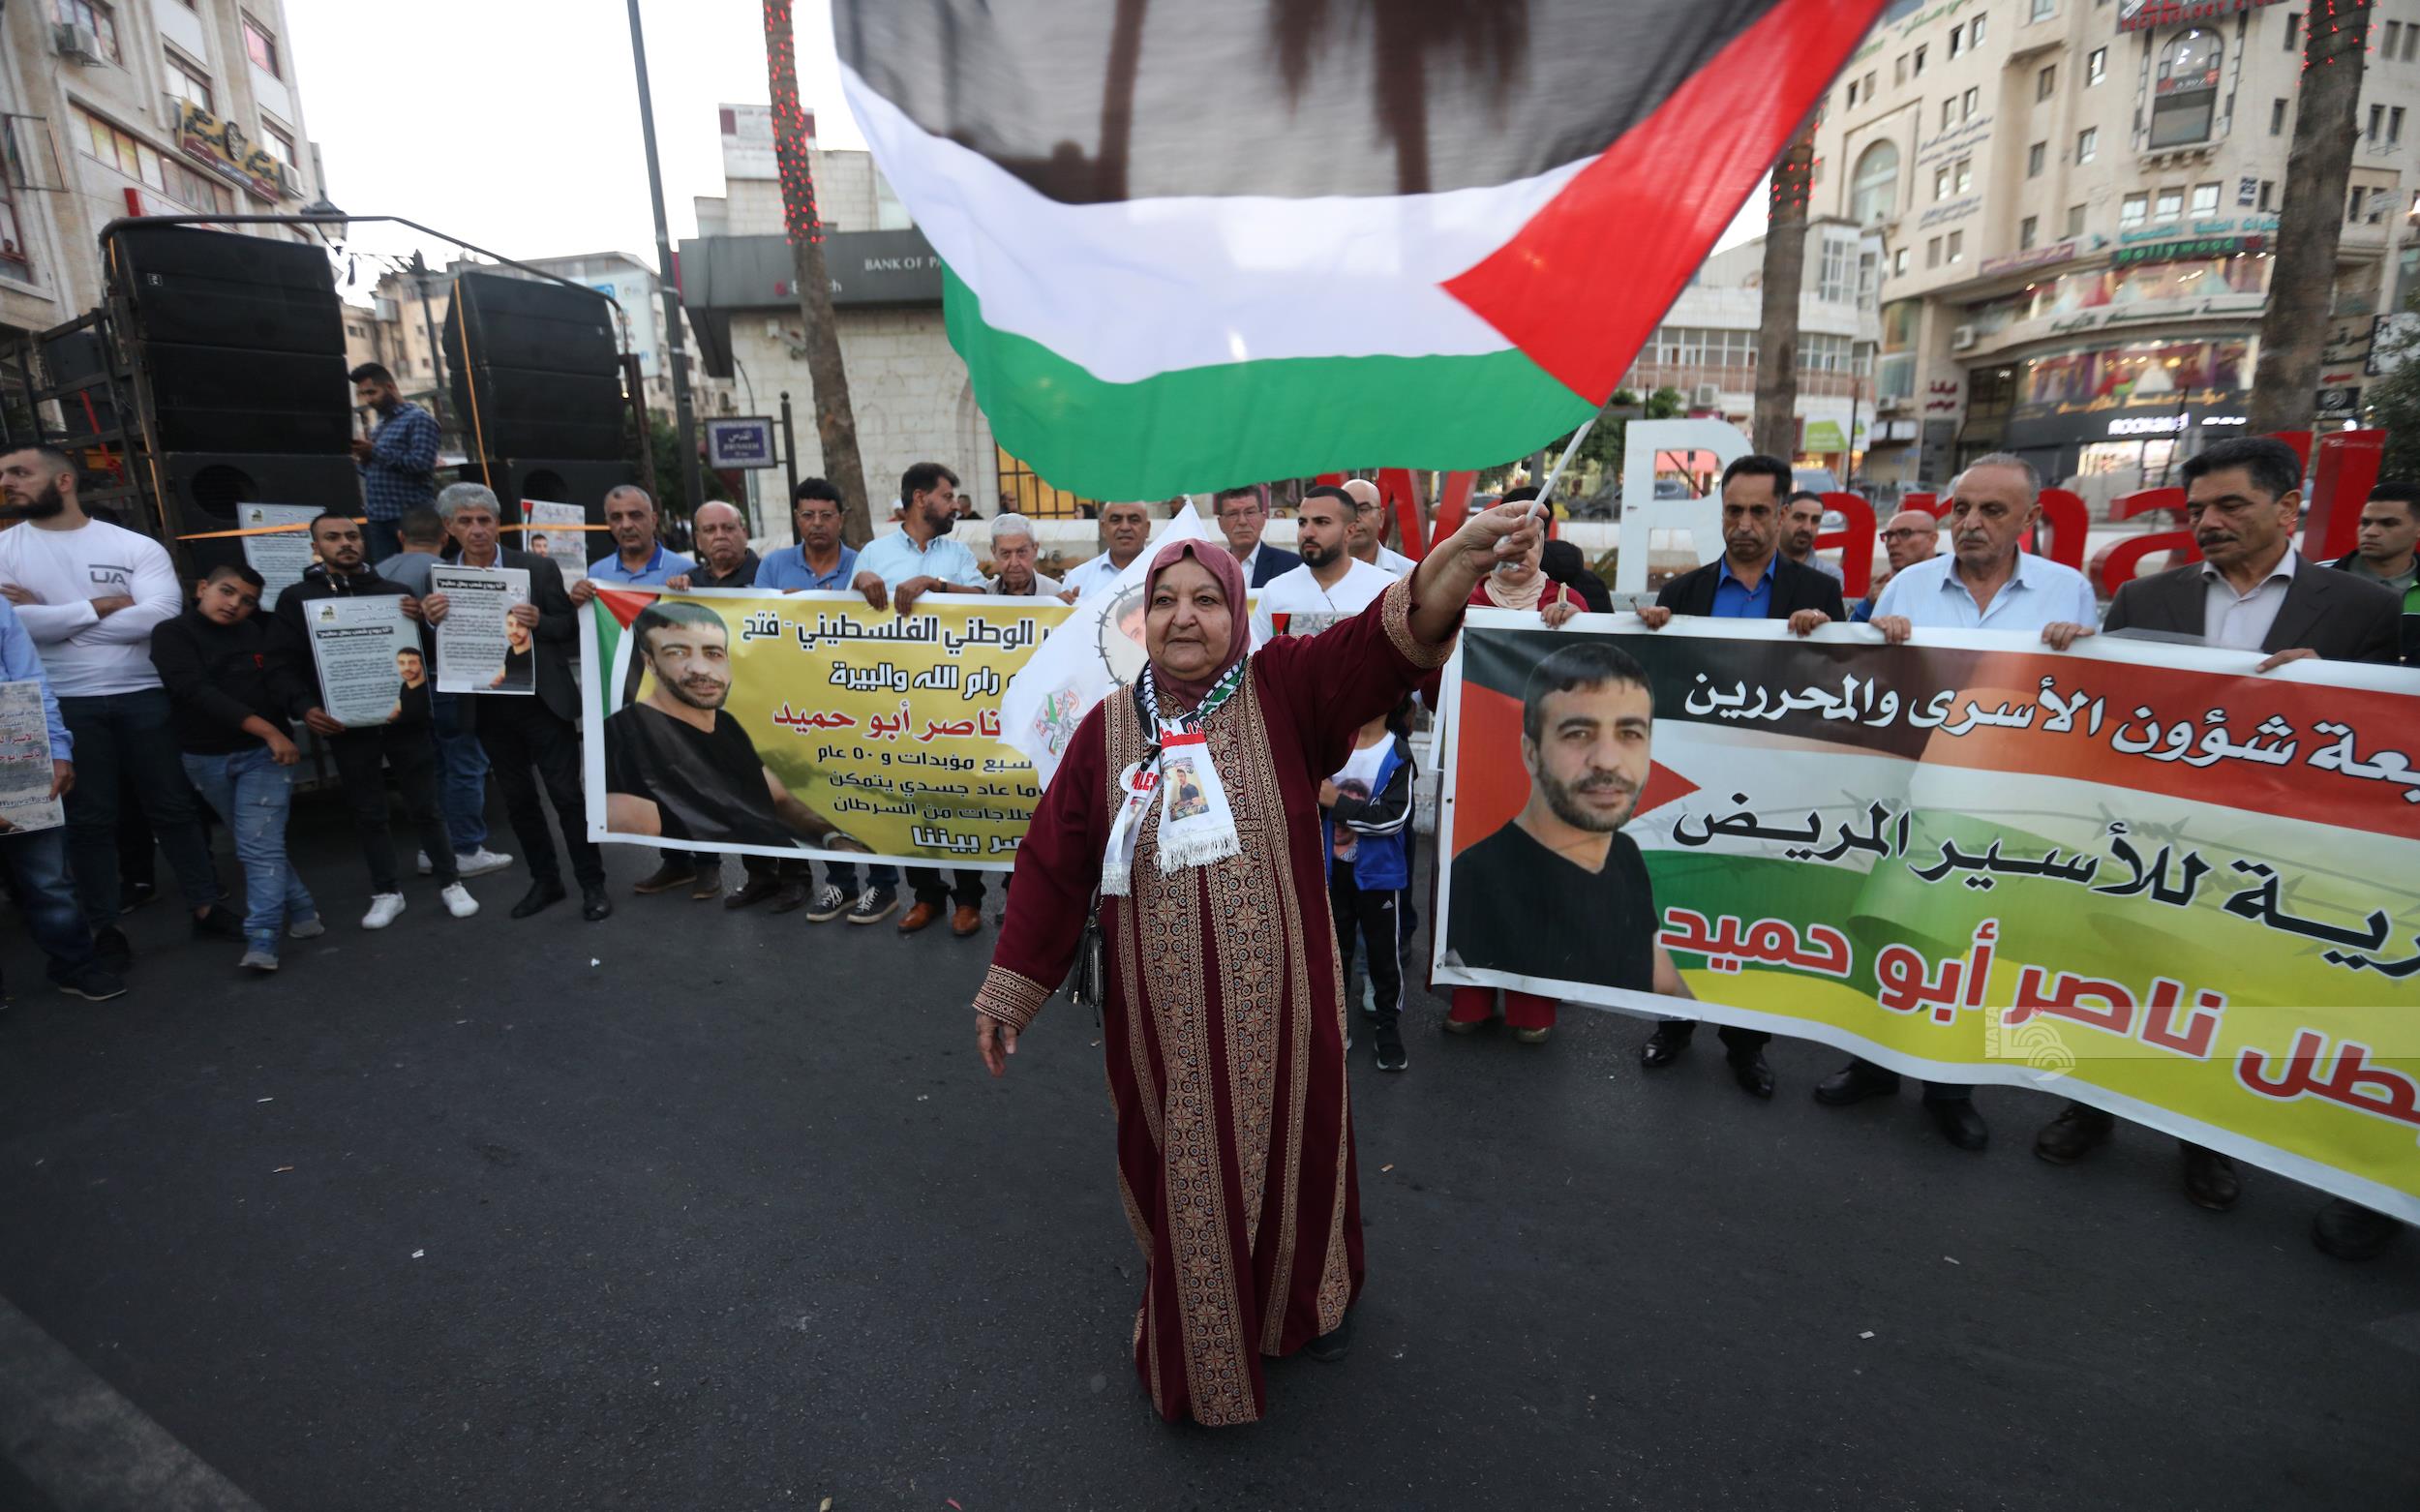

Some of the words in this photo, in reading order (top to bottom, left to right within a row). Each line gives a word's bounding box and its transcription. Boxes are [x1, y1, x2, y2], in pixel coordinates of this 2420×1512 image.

[864, 257, 902, 272] BANK
[903, 256, 923, 271] OF
[2117, 236, 2236, 263] Hollywood
[742, 610, 780, 642] فتح
[797, 612, 939, 650] الفلسطيني
[944, 617, 1035, 656] الوطني
[829, 660, 909, 693] والبيرة
[912, 663, 959, 691] الله
[961, 665, 1001, 701] رام
[1684, 672, 1901, 729] والمحررين
[1907, 676, 2106, 738] الأسرى
[773, 698, 857, 737] حميد
[868, 699, 913, 742] أبو
[915, 709, 1001, 743] ناصر
[817, 743, 847, 764] عام
[2109, 706, 2299, 769] شؤون
[880, 752, 892, 767] و
[897, 750, 976, 771] مؤبدات
[828, 771, 894, 790] يتمكن
[899, 778, 970, 798] جسدي
[976, 780, 1011, 797] عاد
[833, 797, 918, 816] السرطان
[923, 805, 953, 821] من
[911, 825, 981, 854] بيننا
[1672, 790, 1913, 862] المريض
[1907, 820, 2213, 908] للأسير
[1657, 906, 1853, 978] حميد
[1874, 918, 2000, 1026] أبو
[2000, 963, 2227, 1062] ناصر
